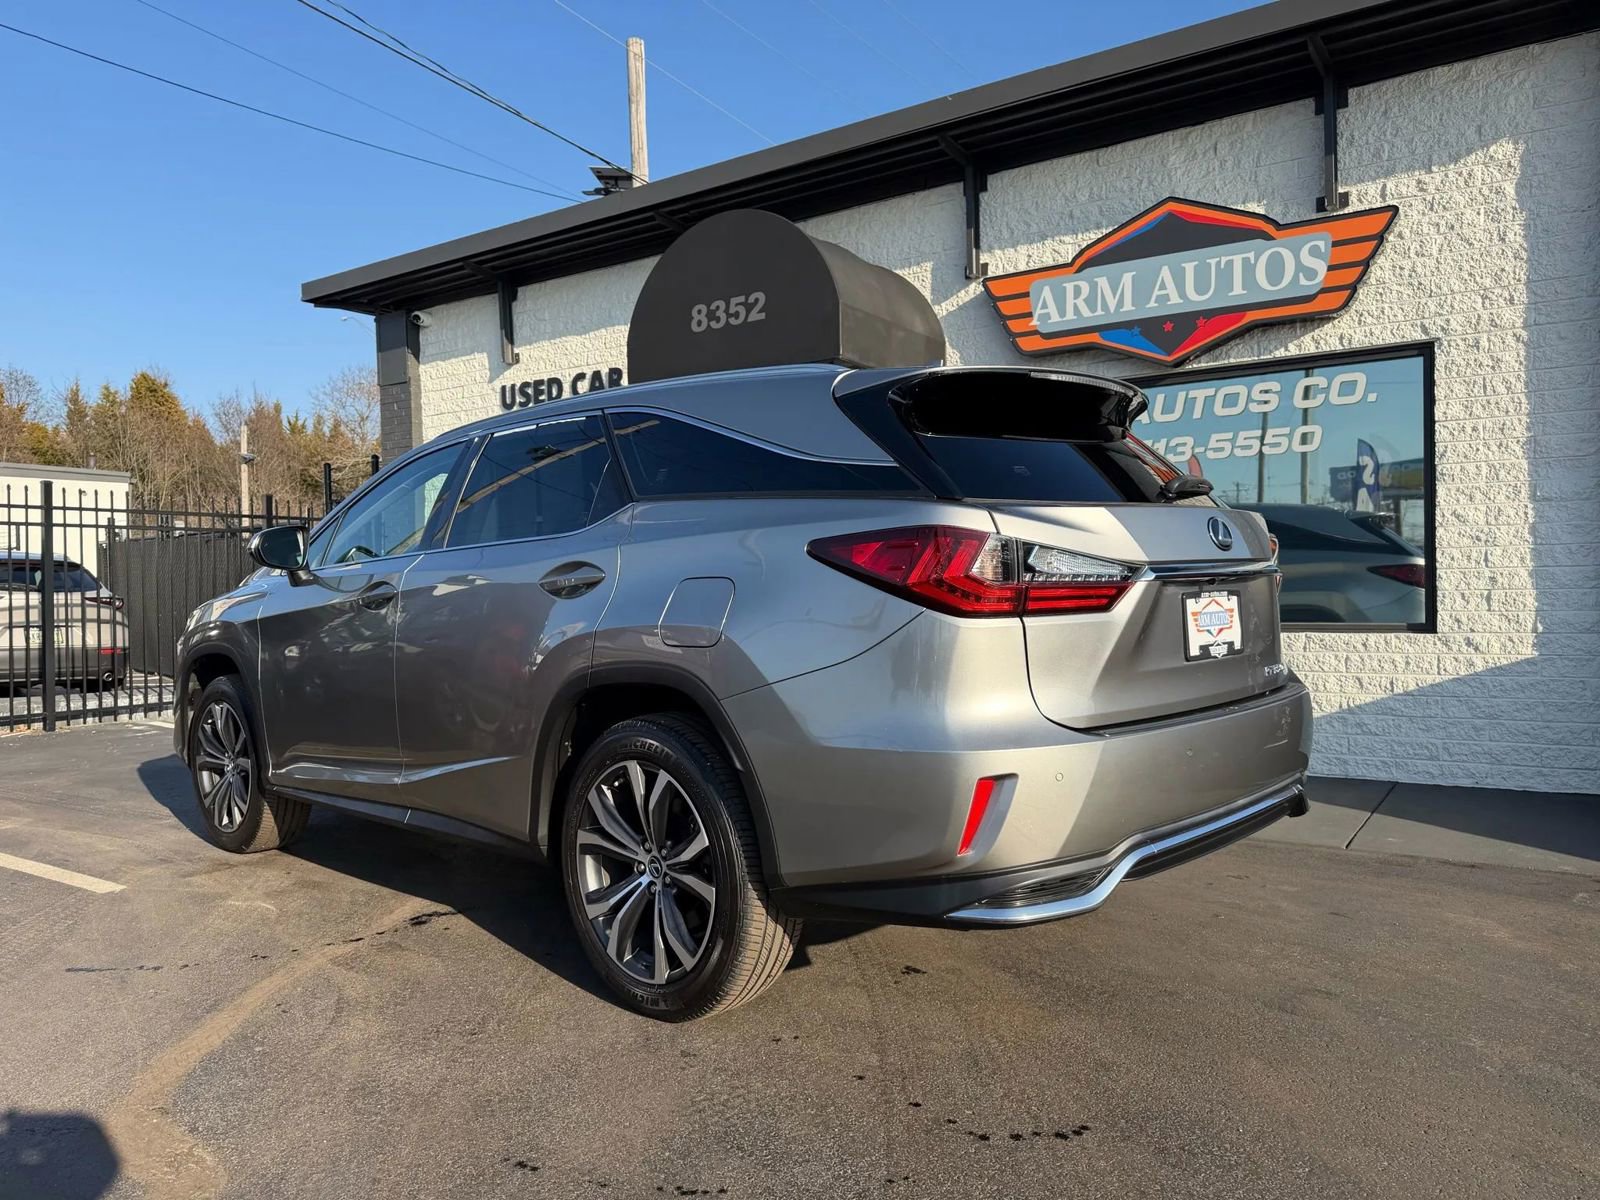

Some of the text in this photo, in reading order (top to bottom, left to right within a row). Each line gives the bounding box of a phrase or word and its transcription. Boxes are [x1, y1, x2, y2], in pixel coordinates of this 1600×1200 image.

[1028, 239, 1327, 326] ARM AUTOS
[690, 291, 766, 332] 8352
[501, 367, 623, 410] USED CAR
[1293, 372, 1377, 408] CO.
[1143, 425, 1323, 463] 13-5550
